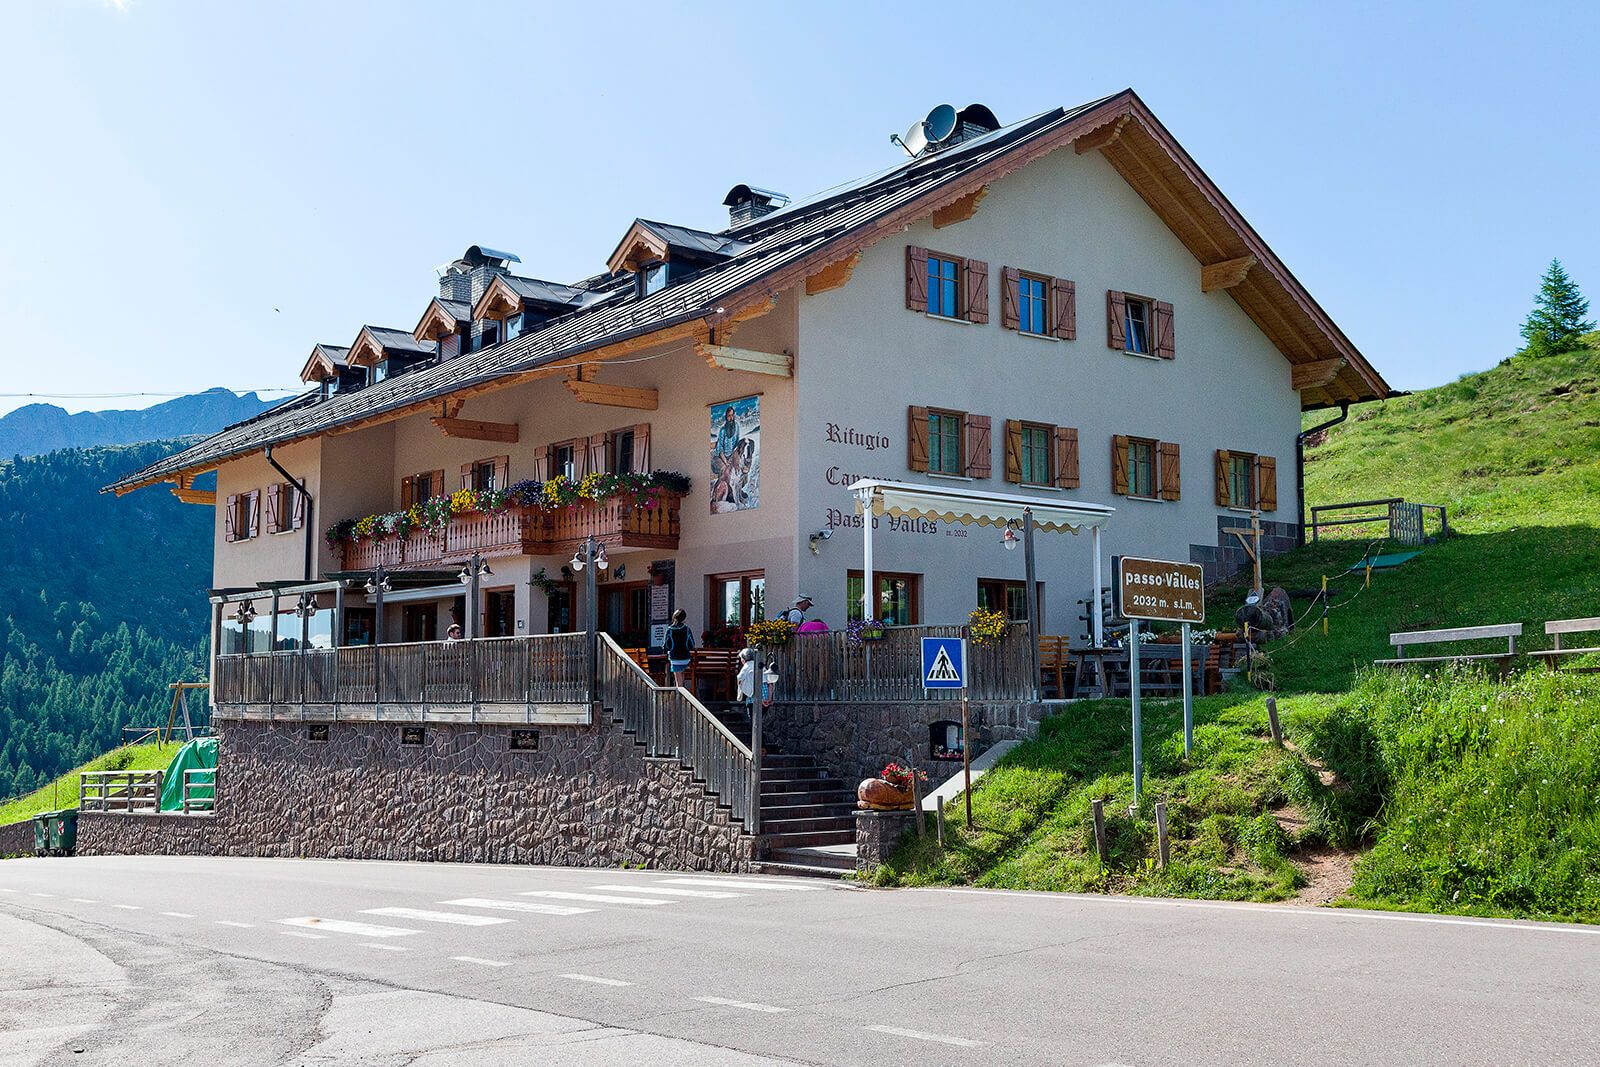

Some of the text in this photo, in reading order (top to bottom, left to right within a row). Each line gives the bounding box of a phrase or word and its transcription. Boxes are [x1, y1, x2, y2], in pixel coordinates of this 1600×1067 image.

[825, 422, 889, 450] Rifugio
[825, 508, 879, 530] Paso
[887, 512, 937, 534] Valles
[954, 529, 968, 538] 2032
[1125, 572, 1162, 586] passo
[1133, 595, 1157, 607] 2032
[1159, 599, 1169, 608] m.
